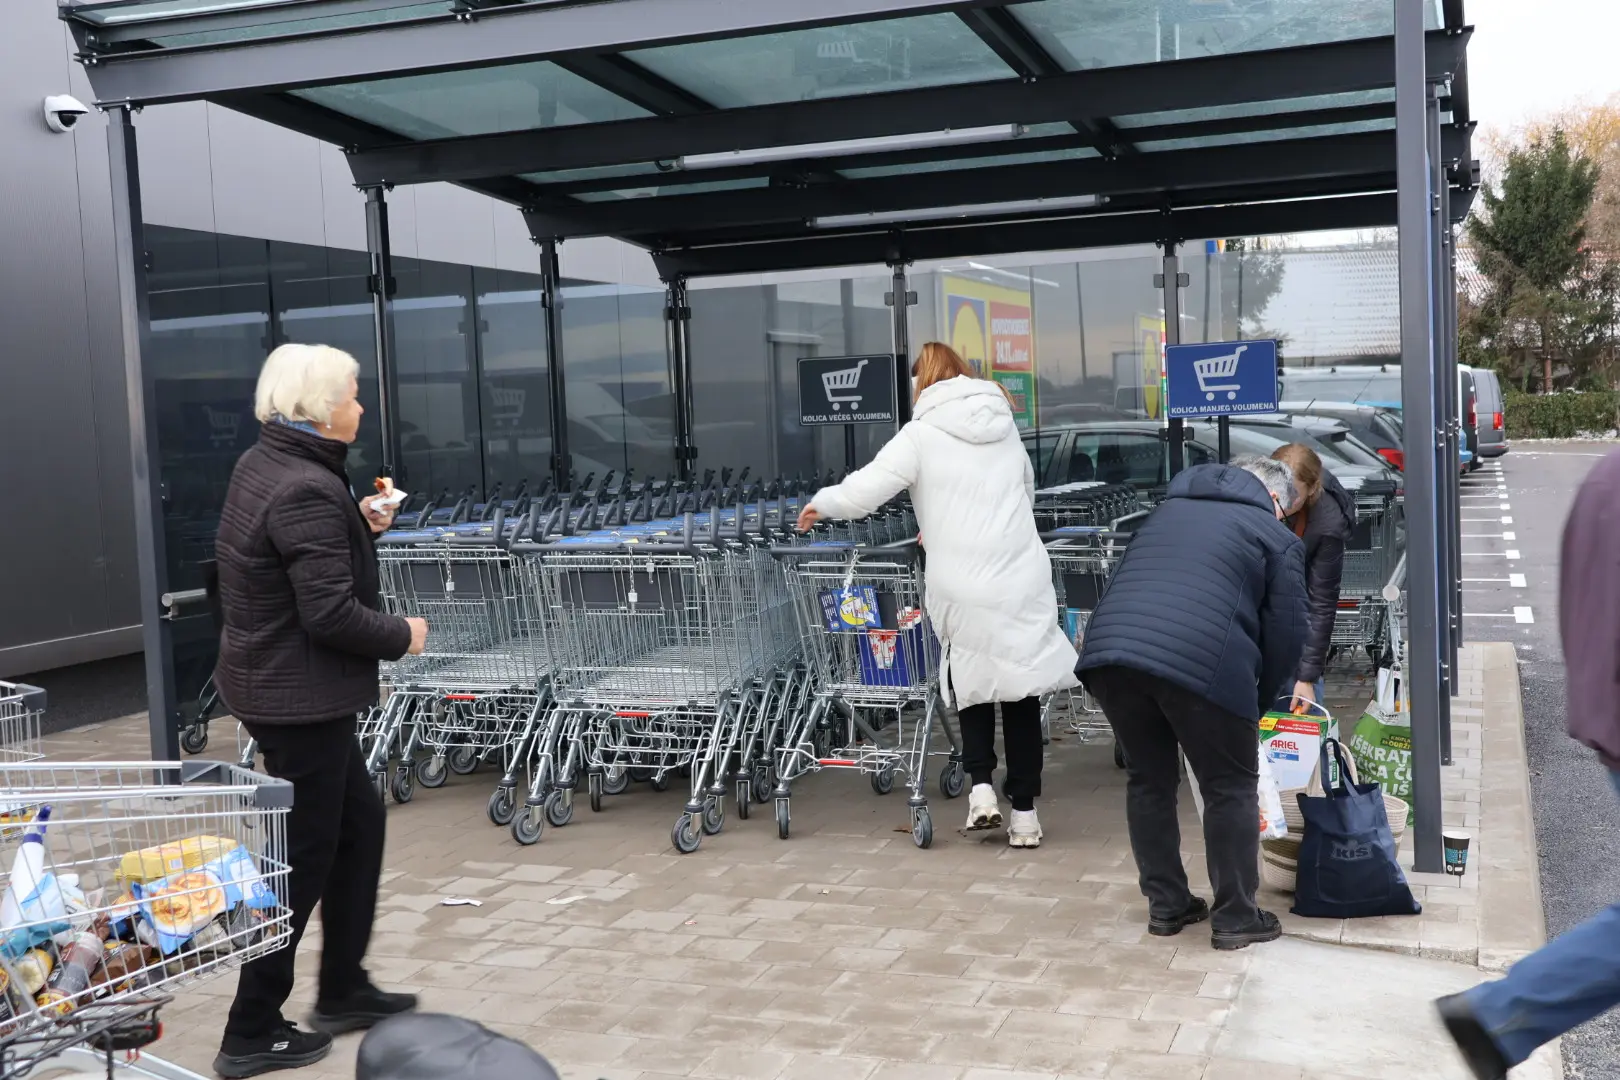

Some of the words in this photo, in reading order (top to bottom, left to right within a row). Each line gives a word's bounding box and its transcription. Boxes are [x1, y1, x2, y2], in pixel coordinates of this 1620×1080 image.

[1171, 406, 1198, 414] KOLICA
[1200, 404, 1231, 413] MANJEG
[1232, 402, 1275, 411] VOLUMENA
[803, 414, 828, 422] KOLICA
[852, 412, 892, 420] VOLUMENA
[1270, 739, 1299, 751] ARIEL
